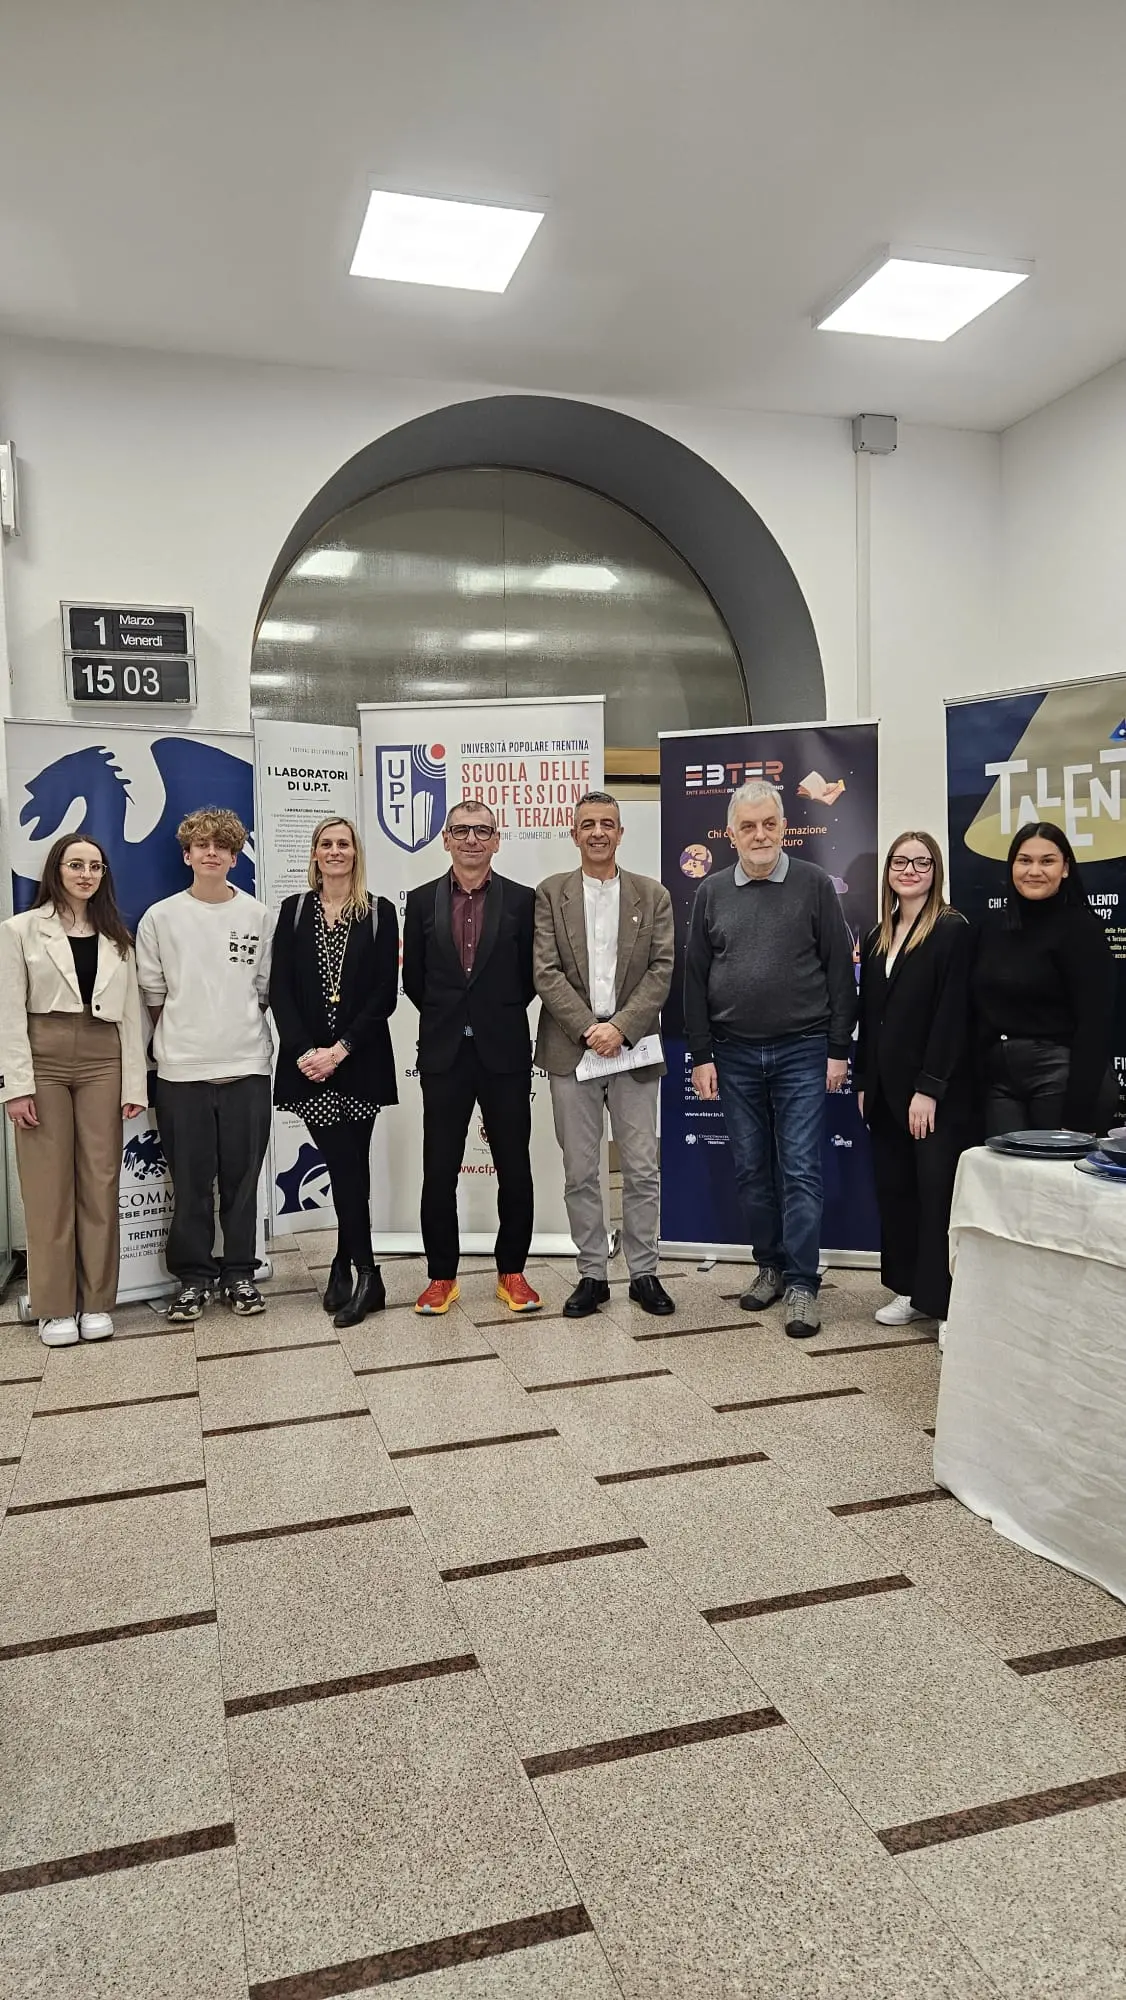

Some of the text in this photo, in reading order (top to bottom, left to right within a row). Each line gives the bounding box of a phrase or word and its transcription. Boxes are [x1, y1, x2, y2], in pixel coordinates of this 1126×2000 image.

[119, 614, 155, 626] Marzo
[94, 617, 106, 645] 1
[120, 634, 163, 647] Venerdi
[81, 664, 160, 695] 15 03
[461, 739, 589, 754] UNIVERSITÀ POPOLARE TRENTINA
[267, 766, 348, 780] I LABORATORI
[462, 760, 590, 783] SCUOLA DELLE
[685, 761, 784, 787] EBTER
[287, 781, 331, 793] DI U.P.T.
[463, 784, 589, 806] PROFESSIONI
[985, 747, 1126, 847] TALENT
[515, 807, 574, 828] TERZIAR
[518, 831, 552, 841] COMMERCIO
[707, 830, 722, 839] Chi
[784, 825, 828, 837] rmazione
[988, 898, 1002, 909] CHI
[143, 1207, 166, 1216] PER
[128, 1228, 169, 1241] TRENTIN
